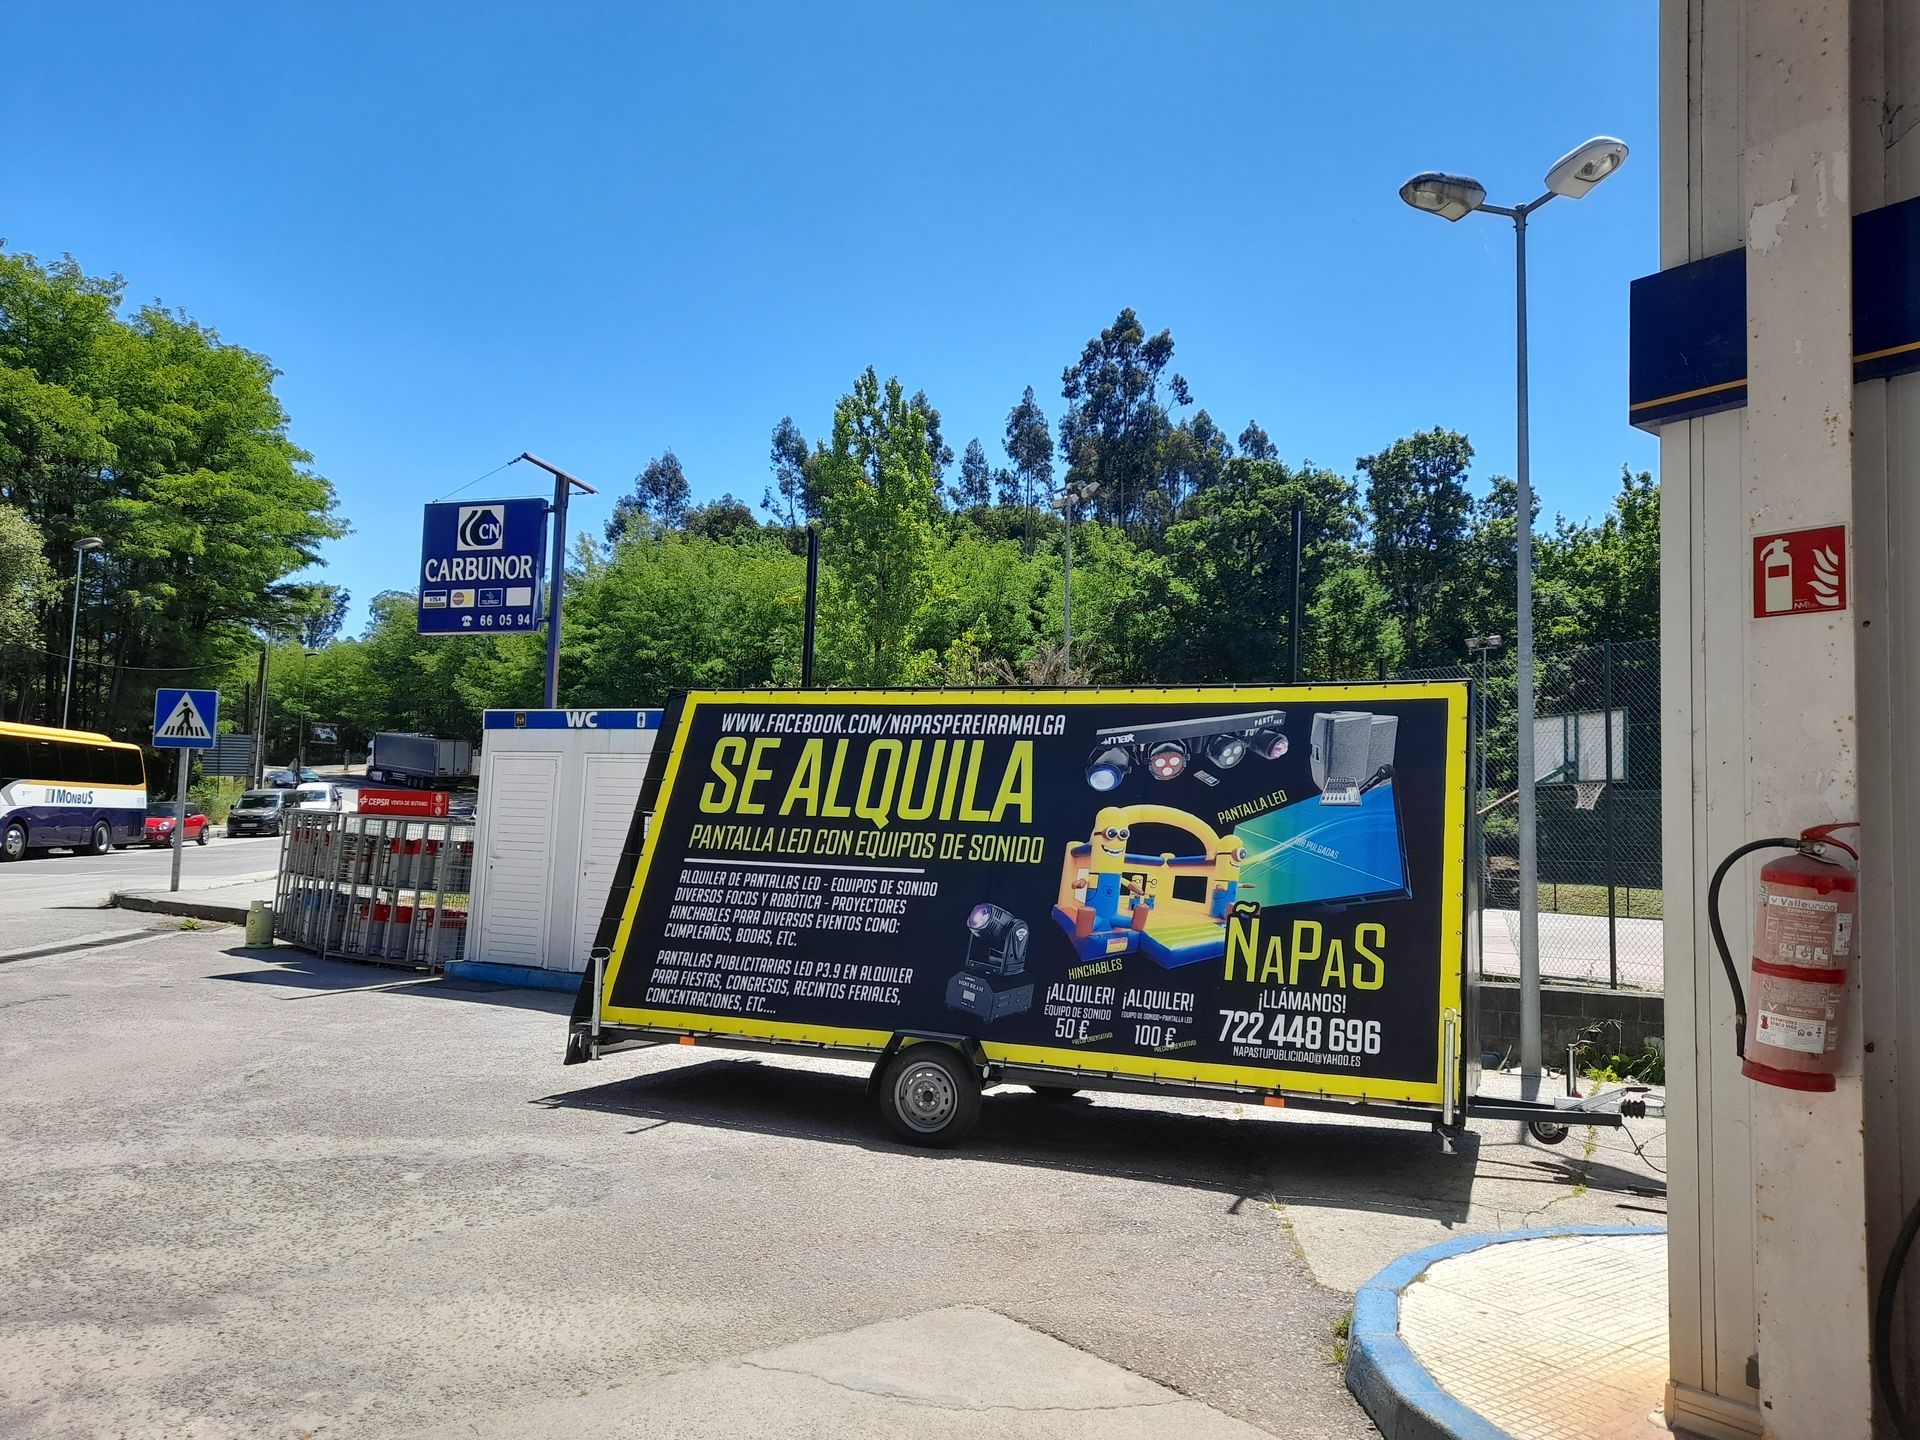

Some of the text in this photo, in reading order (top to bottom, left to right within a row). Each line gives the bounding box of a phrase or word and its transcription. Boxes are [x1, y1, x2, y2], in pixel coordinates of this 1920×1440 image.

[479, 523, 500, 539] CN
[425, 555, 533, 582] CARBUNOR
[480, 614, 530, 626] 66 05 94
[565, 711, 598, 728] WC
[721, 713, 1066, 736] WWW.FACEBOOK.COM/NAPASPEREIRAMALGA
[699, 736, 1034, 829] SE ALQUILA
[368, 798, 390, 806] CEPSA
[1217, 789, 1288, 825] PANTALLA LED
[688, 825, 1044, 863] PANTALLA LED CON EQUIPOS DE SONIDO
[680, 870, 727, 886] ALQUILER
[728, 872, 742, 887] DE
[743, 873, 800, 890] PANTALLAS
[802, 876, 821, 891] LED
[831, 877, 877, 894] EQUIPOS
[880, 880, 894, 895] DE
[896, 881, 938, 897] SONIDO
[674, 887, 723, 903] DIVERSOS
[725, 890, 759, 906] FOCOS
[761, 892, 769, 906] Y
[769, 891, 822, 909] ROBÓTICA
[831, 896, 907, 914] PROYECTORES
[1781, 898, 1835, 912] Valleunión
[669, 905, 900, 933] HINCHABLES PARA DIVERSOS EVENTOS COMO:
[664, 923, 798, 947] CUMPLEAÑOS, BODAS, ETC.
[656, 950, 913, 984] PANTALLAS PUBLICITARIAS LED P3.9 EN ALQUILER
[1068, 958, 1123, 980] HINCHABLES
[651, 968, 901, 1006] PARA FIESTAS, CONGRESOS, RECINTOS FERIALES,
[1046, 983, 1115, 1005] ¡ALQUILER!
[645, 987, 742, 1012] CONCENTRACIONES,
[1122, 988, 1194, 1011] ¡ALQUILER!
[1258, 987, 1347, 1014] ¡LLÁMANOS!
[1044, 1004, 1111, 1021] EQUIPO DE SONIDO
[1055, 1017, 1089, 1040] 50 €
[1134, 1024, 1177, 1048] 100 €
[1219, 1009, 1382, 1055] 722 448 696
[1233, 1045, 1361, 1067] NAPASTUPUBLICIDAD@YAHOO.ES
